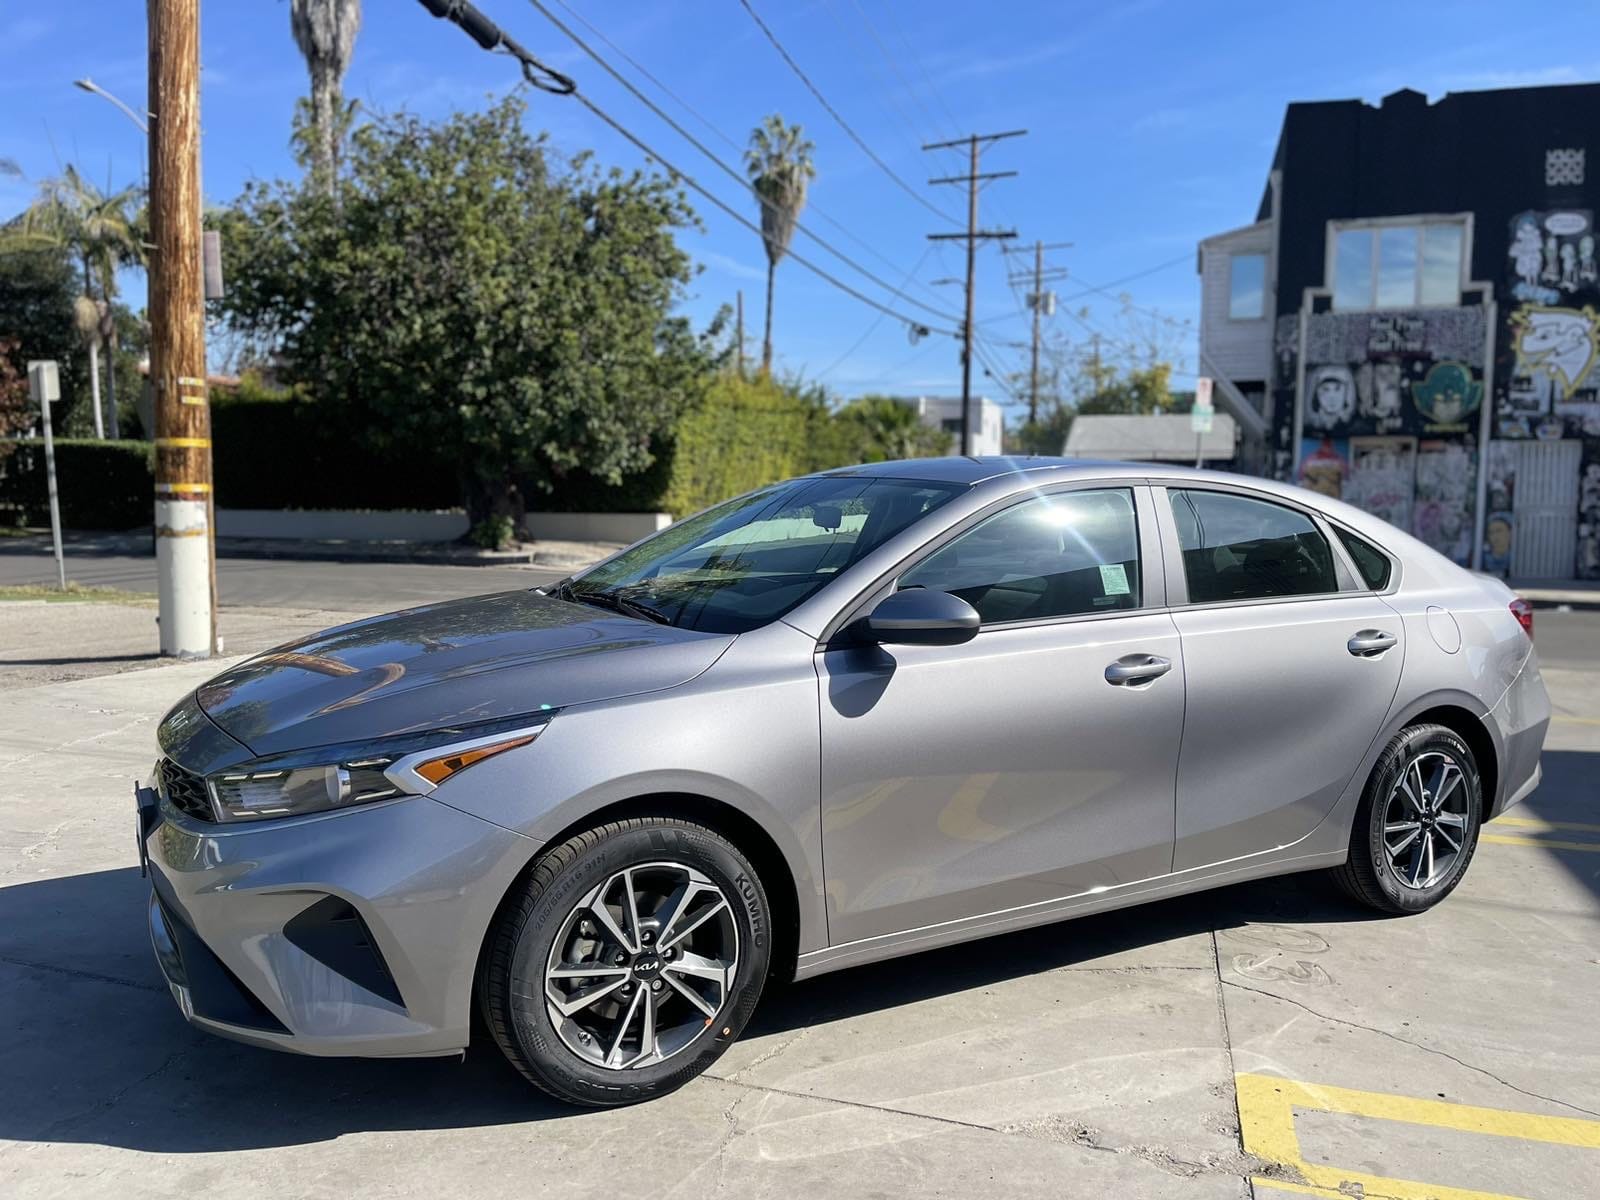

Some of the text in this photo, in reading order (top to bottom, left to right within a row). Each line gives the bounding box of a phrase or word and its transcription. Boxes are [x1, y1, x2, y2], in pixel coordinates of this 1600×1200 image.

[561, 871, 582, 893] R16
[584, 853, 606, 872] 91H
[735, 873, 763, 948] KUMHO
